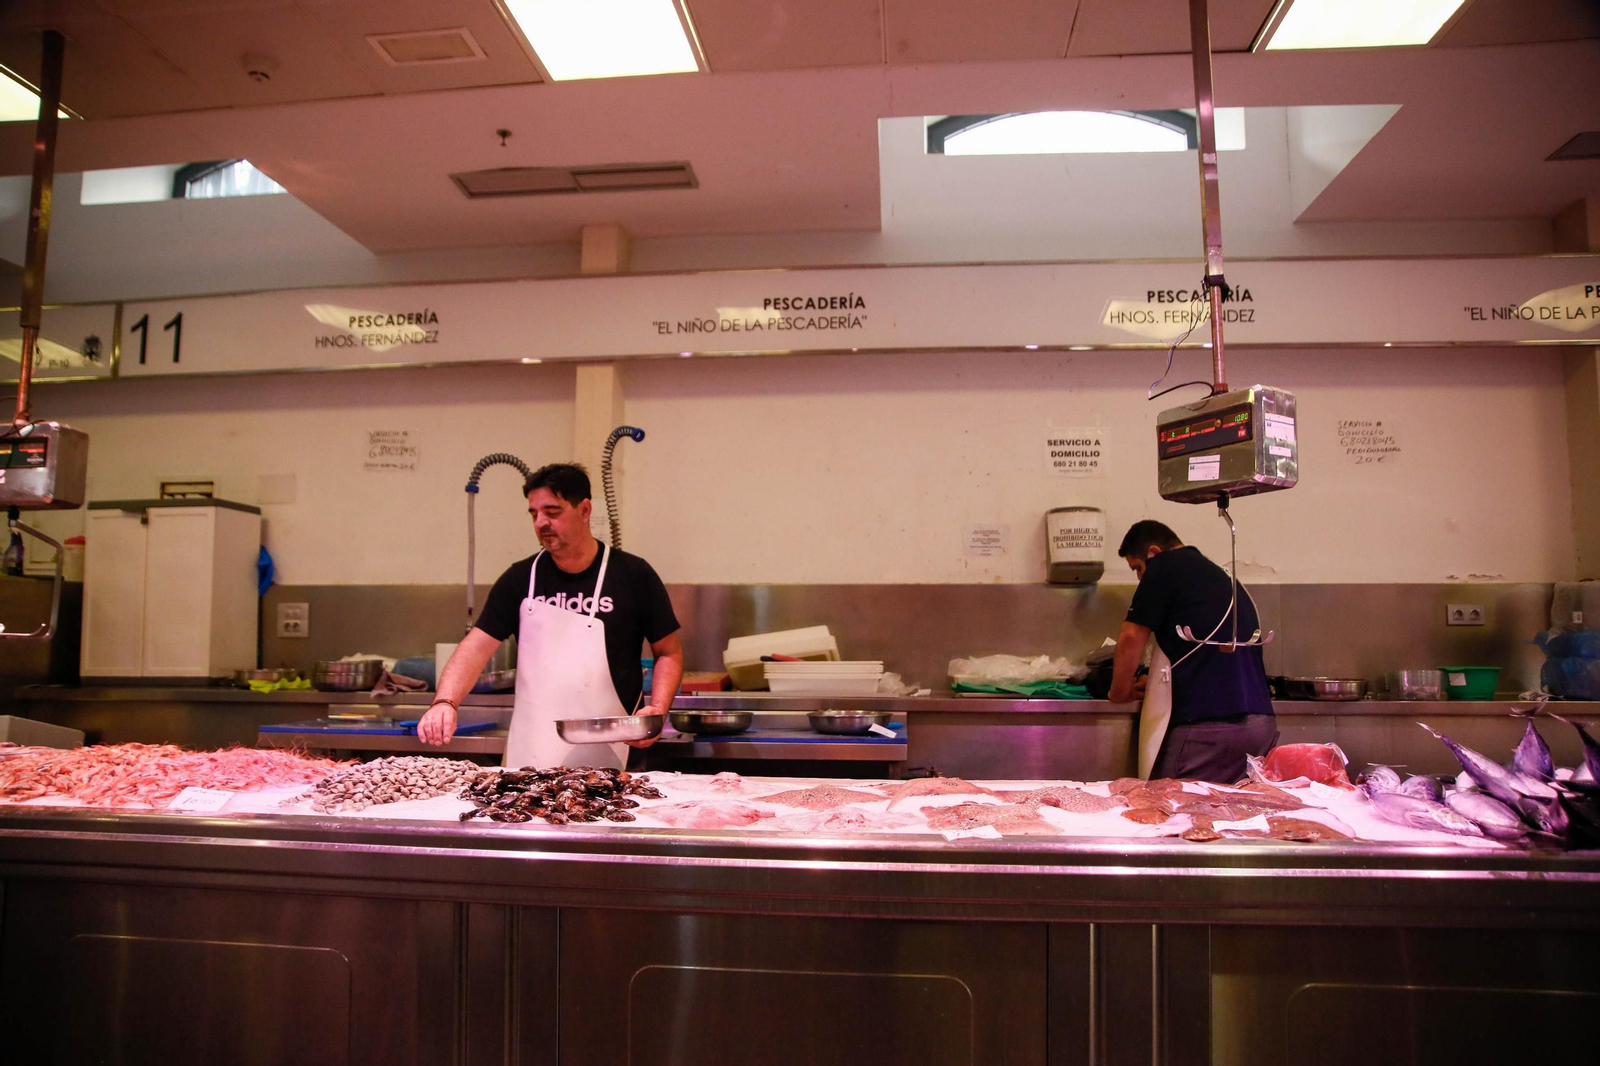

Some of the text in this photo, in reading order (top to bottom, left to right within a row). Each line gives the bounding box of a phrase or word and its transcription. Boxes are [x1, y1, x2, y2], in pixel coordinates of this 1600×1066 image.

[763, 292, 866, 310] PESCADERÍA
[1147, 284, 1253, 303] PESCADRÍA
[348, 308, 439, 328] PESCADERÍA
[1110, 310, 1159, 324] HNOS.
[1464, 306, 1487, 321] "EL
[1492, 304, 1535, 320] NIÑO
[1540, 306, 1561, 319] DE
[1566, 306, 1586, 319] LA
[652, 313, 867, 334] "EL NIÑO DE LA PESCADERÍA"
[130, 312, 183, 364] 11
[315, 328, 439, 349] HNOS. FERNÁNDEZ
[1338, 420, 1372, 429] SERVICIO
[1340, 435, 1395, 446] 680218045
[1051, 450, 1100, 458] DOMICILIO
[1056, 541, 1065, 549] LA
